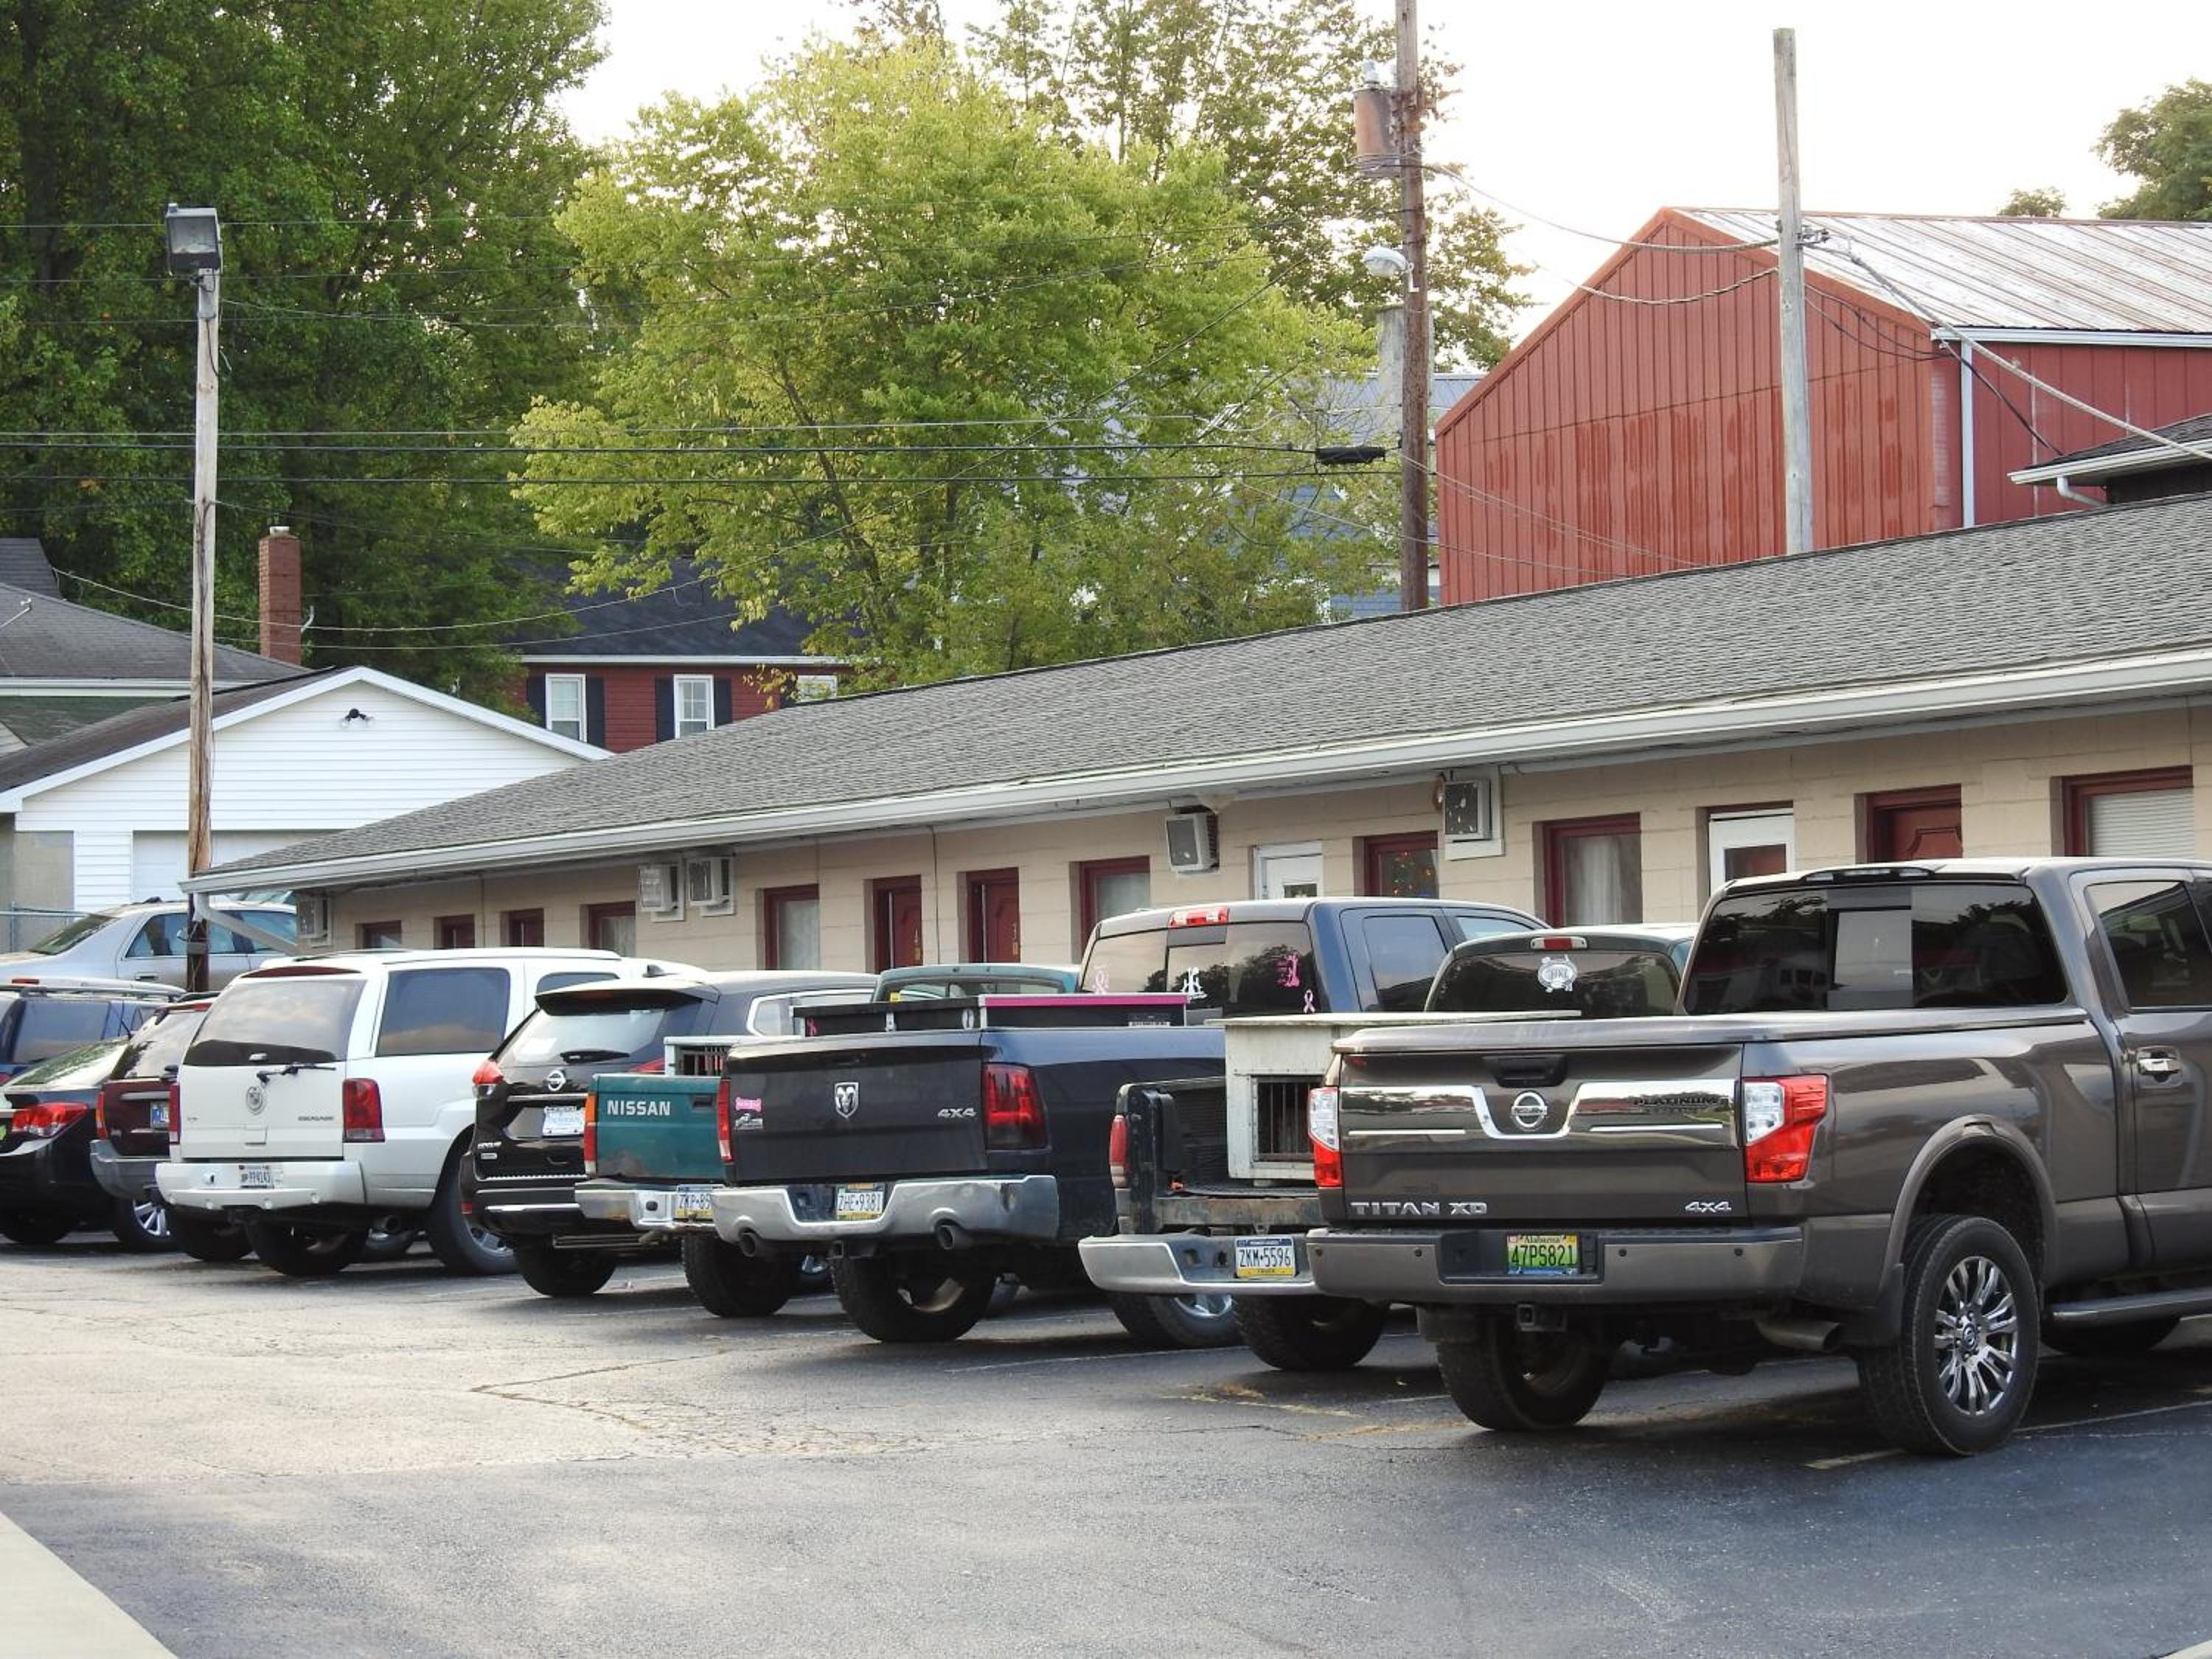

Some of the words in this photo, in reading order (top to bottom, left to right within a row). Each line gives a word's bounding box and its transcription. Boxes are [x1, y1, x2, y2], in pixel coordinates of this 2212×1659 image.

[606, 1099, 671, 1116] NISSAN
[1632, 1096, 1719, 1106] PLATINUM
[1350, 1201, 1440, 1216] TITAN
[1448, 1201, 1487, 1216] XD
[1511, 1244, 1576, 1267] 47PS821
